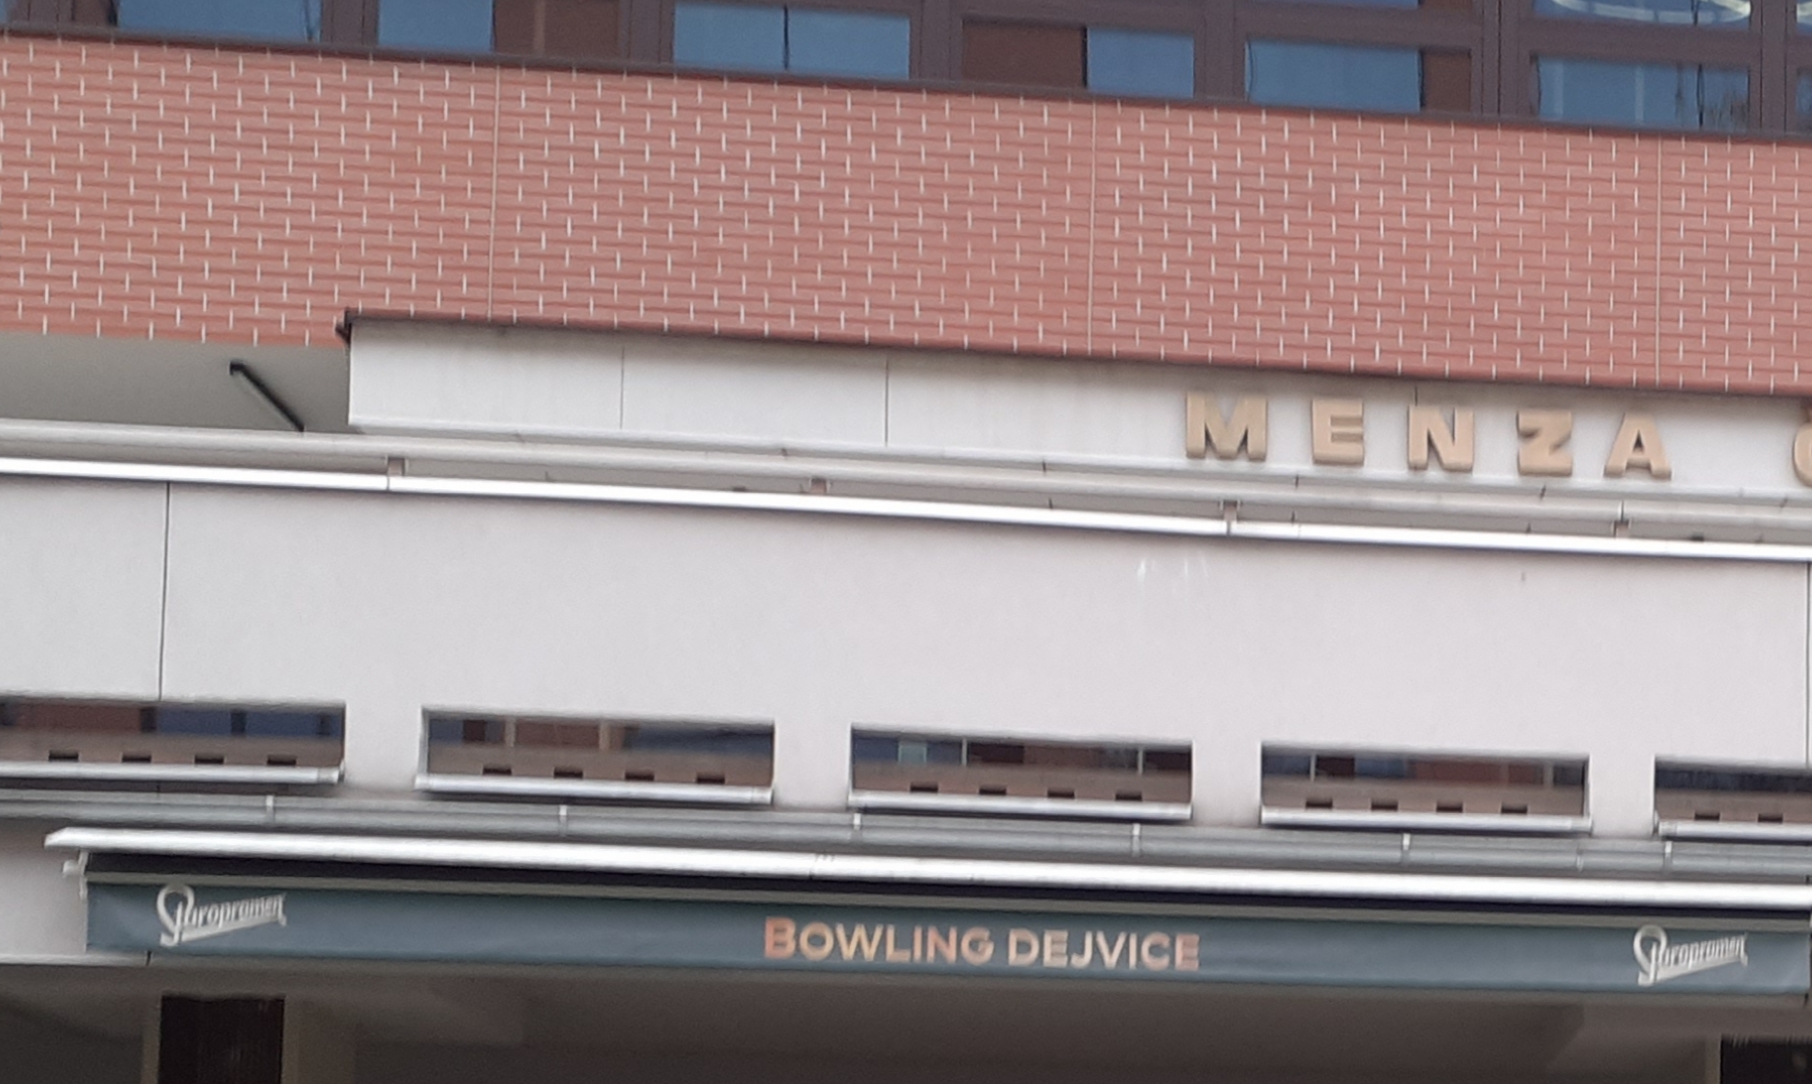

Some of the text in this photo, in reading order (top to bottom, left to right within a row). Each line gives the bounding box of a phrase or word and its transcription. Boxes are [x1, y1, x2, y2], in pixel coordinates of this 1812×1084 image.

[1185, 390, 1672, 480] MENZA
[157, 884, 288, 947] Staropramen
[764, 916, 1200, 972] BOWLING DEJVICE
